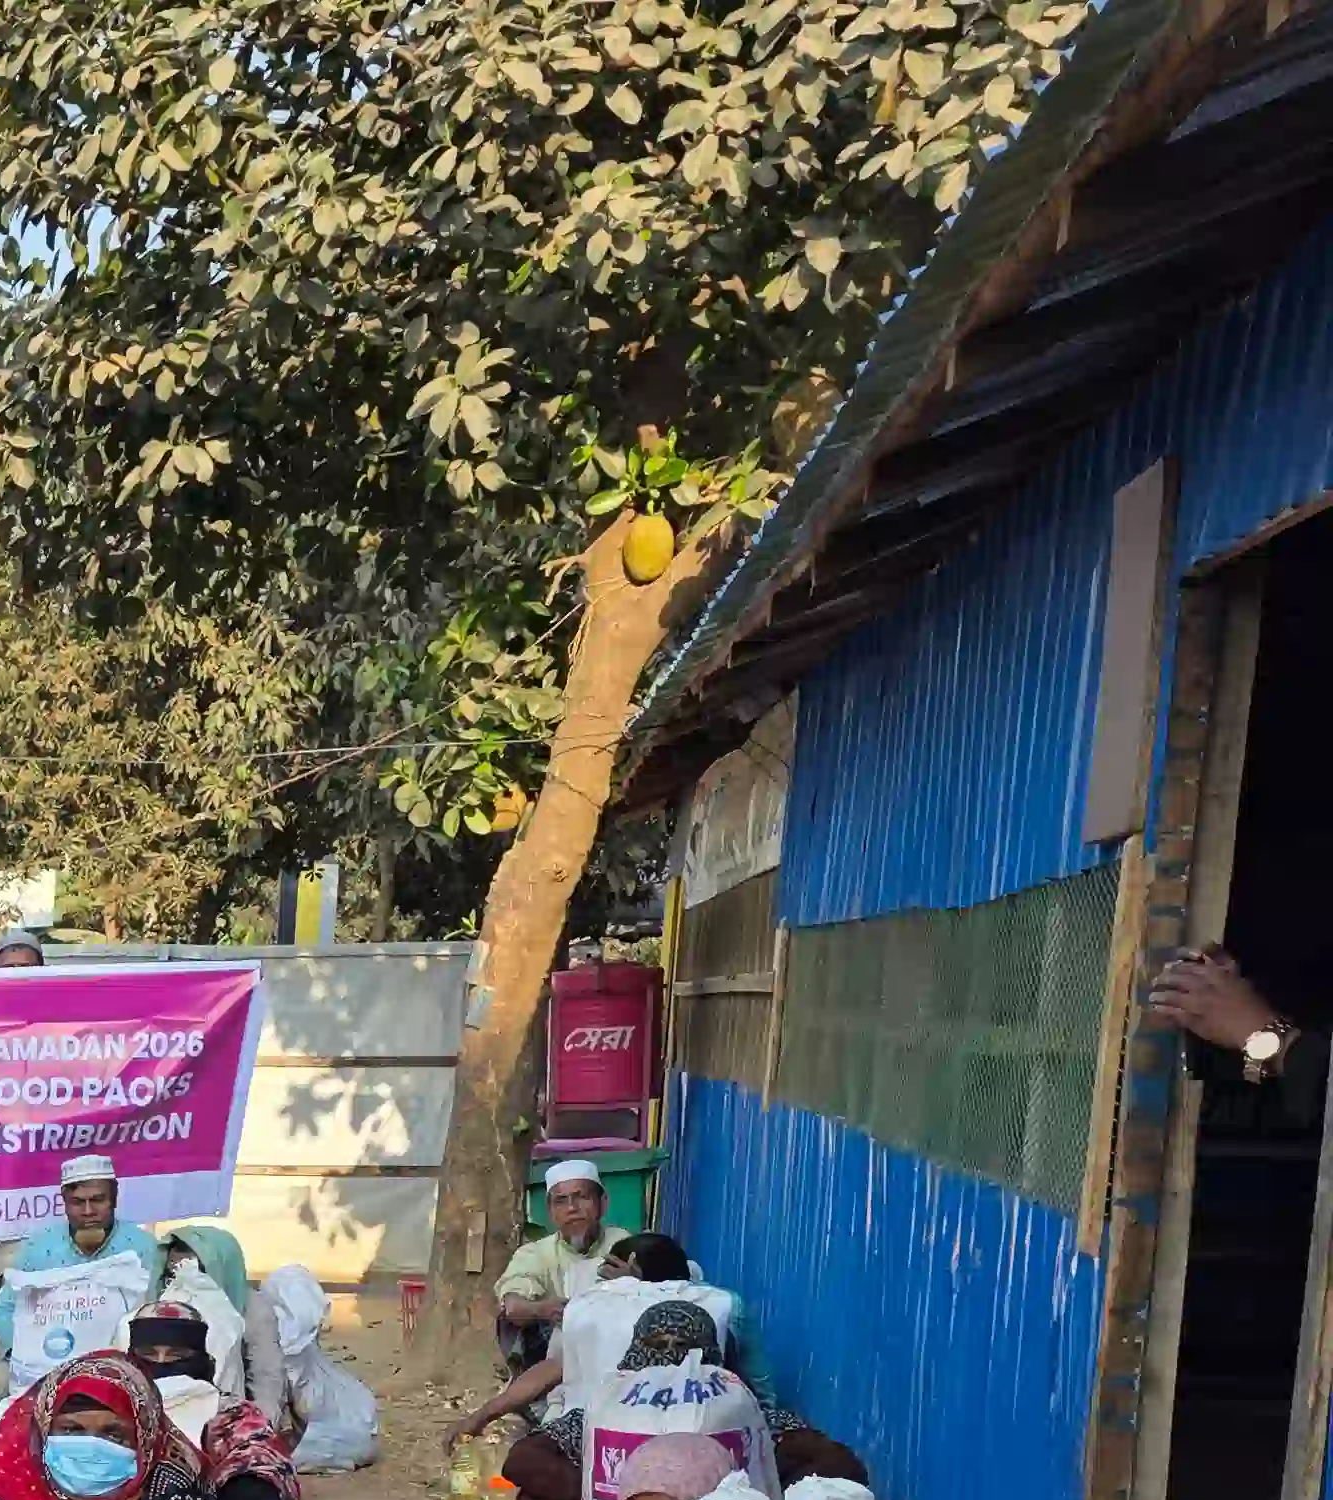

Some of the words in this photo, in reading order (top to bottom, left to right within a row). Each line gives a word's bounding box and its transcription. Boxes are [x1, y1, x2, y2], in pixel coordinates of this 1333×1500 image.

[132, 1029, 204, 1060] 2026
[563, 1025, 636, 1052] সেরা
[81, 1071, 193, 1107] PACKS
